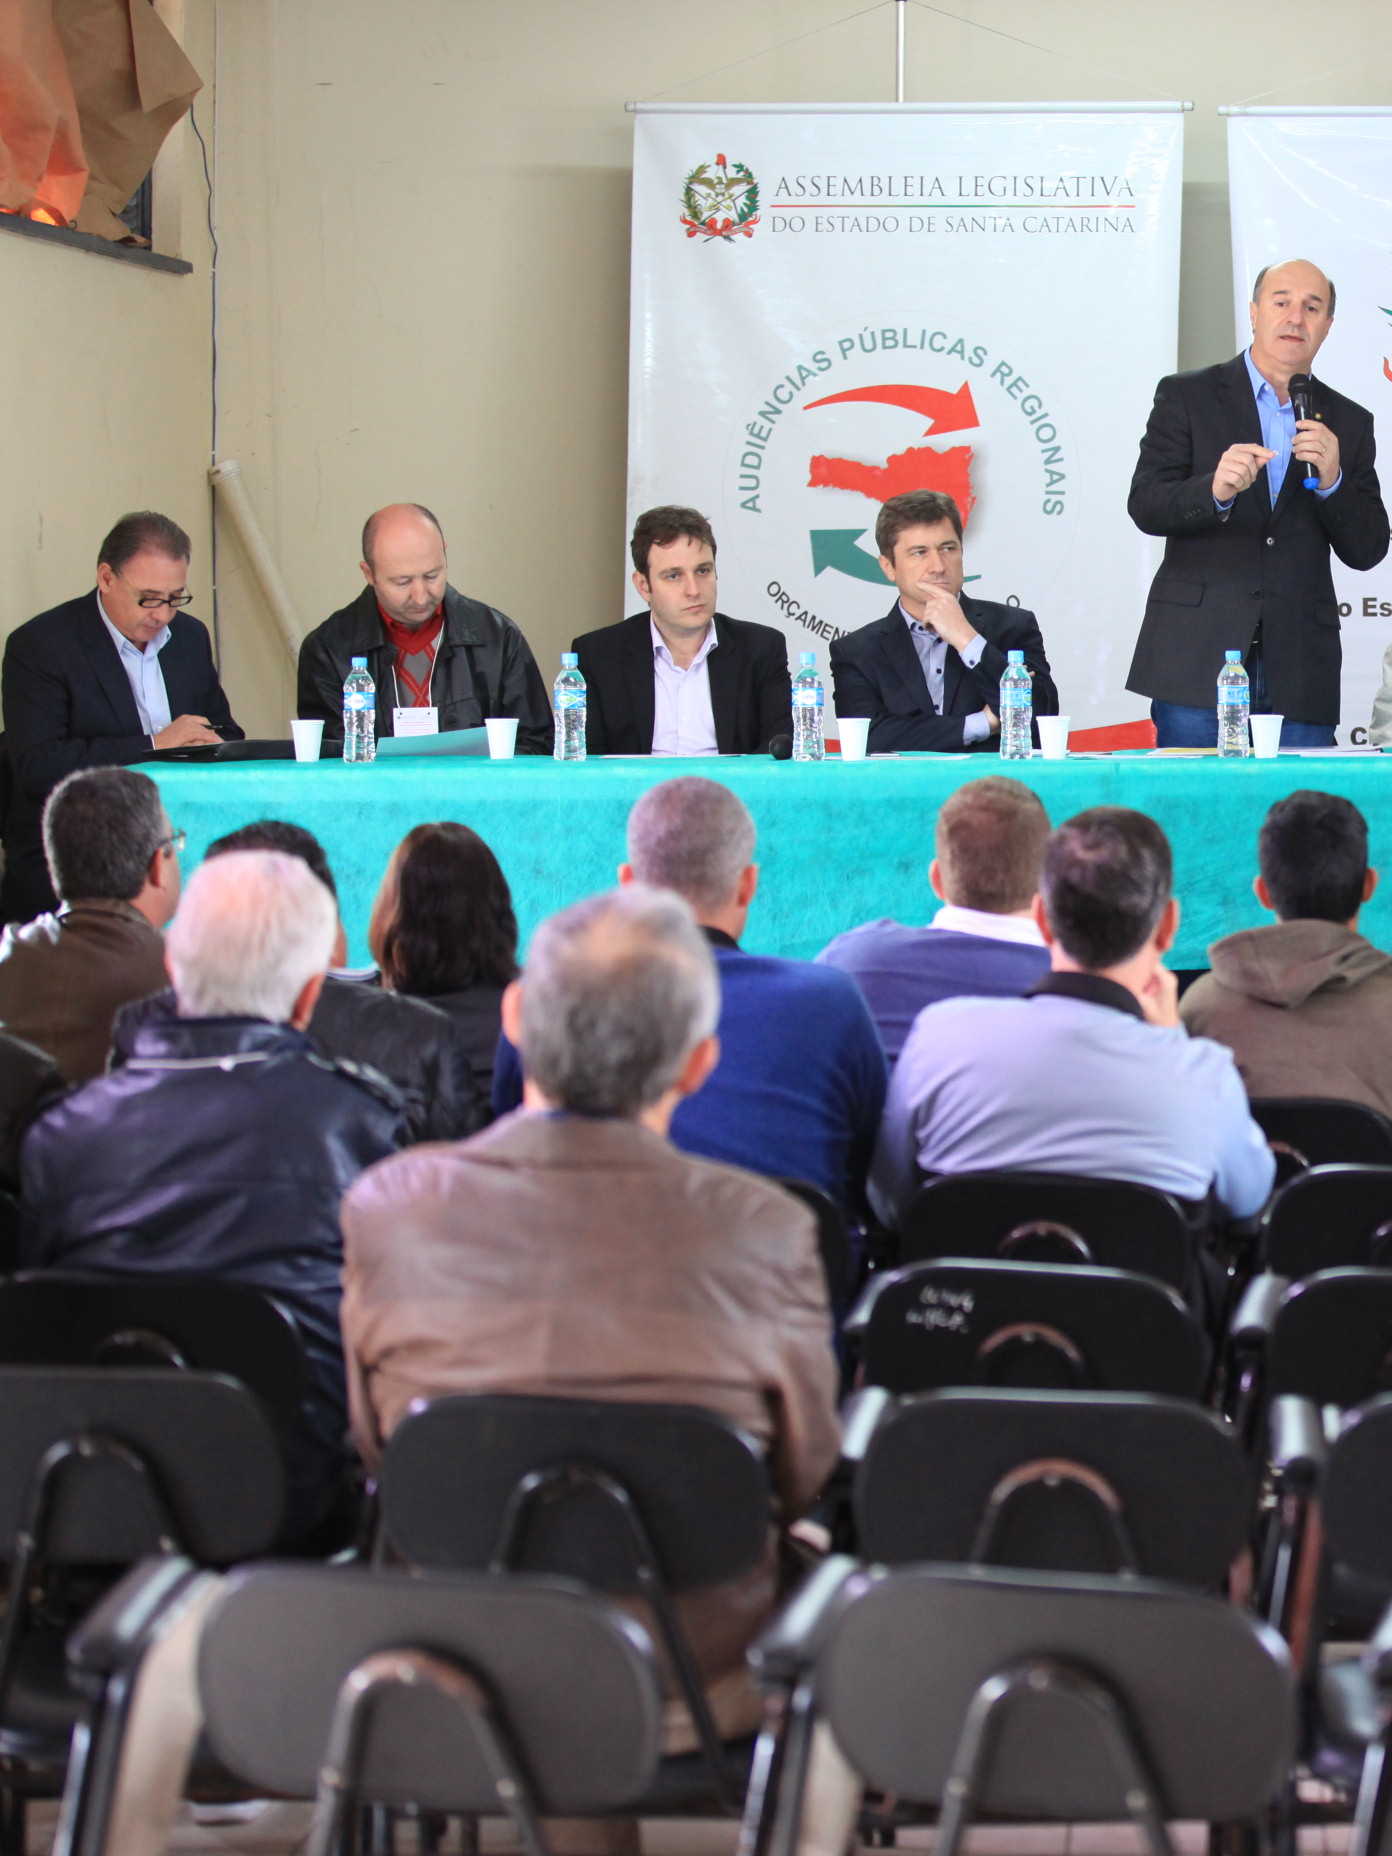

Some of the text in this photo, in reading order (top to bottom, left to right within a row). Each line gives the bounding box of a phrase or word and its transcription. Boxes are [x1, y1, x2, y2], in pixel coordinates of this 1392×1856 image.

[774, 175, 1135, 198] ASSEMBLEIA LEGISLATIVA
[771, 215, 806, 233] DO
[814, 215, 899, 233] ESTADO
[908, 215, 936, 233] DE
[944, 215, 1016, 233] SANTA
[1022, 215, 1136, 234] CATARINA
[738, 326, 1066, 517] AUDIÊNCIAS PÚBLICAS REGIONAIS
[767, 581, 853, 641] ORÇAMEN
[1338, 601, 1352, 617] o
